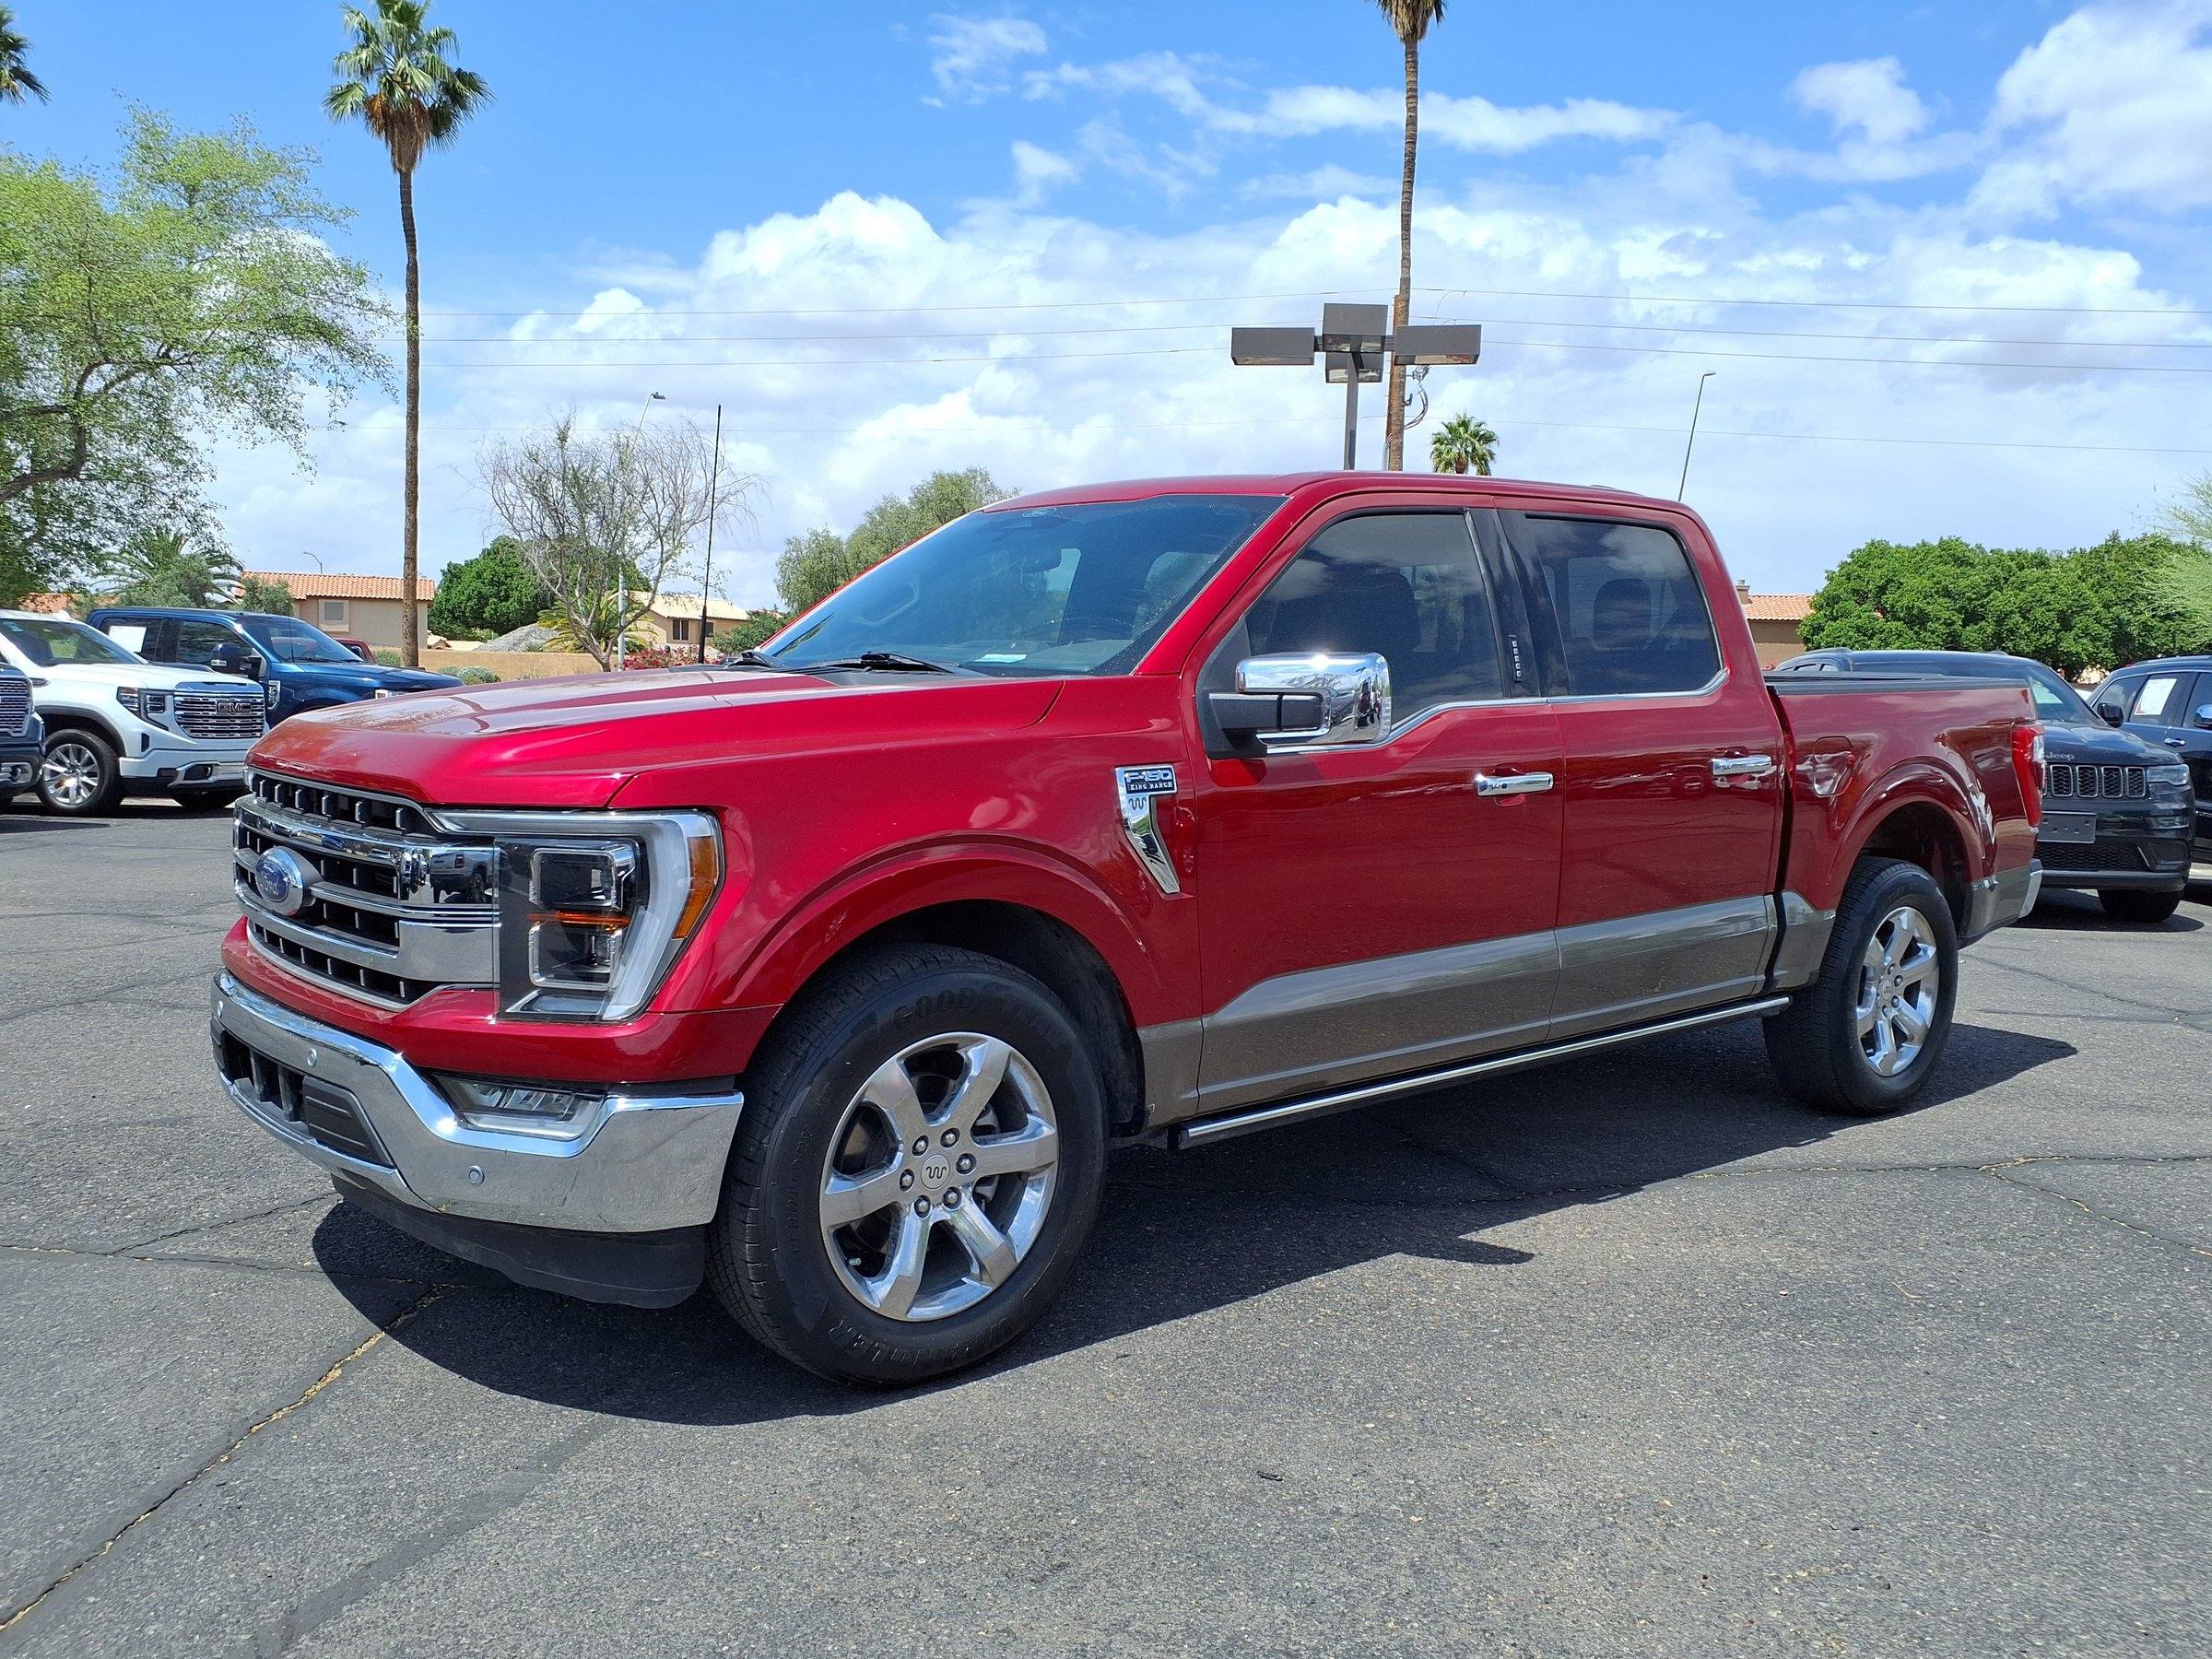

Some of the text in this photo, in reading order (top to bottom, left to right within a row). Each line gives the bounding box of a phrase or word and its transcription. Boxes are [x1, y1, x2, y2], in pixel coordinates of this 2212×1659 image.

[218, 701, 252, 712] GMC
[2046, 751, 2075, 761] Jeep
[1124, 770, 1172, 782] F-150
